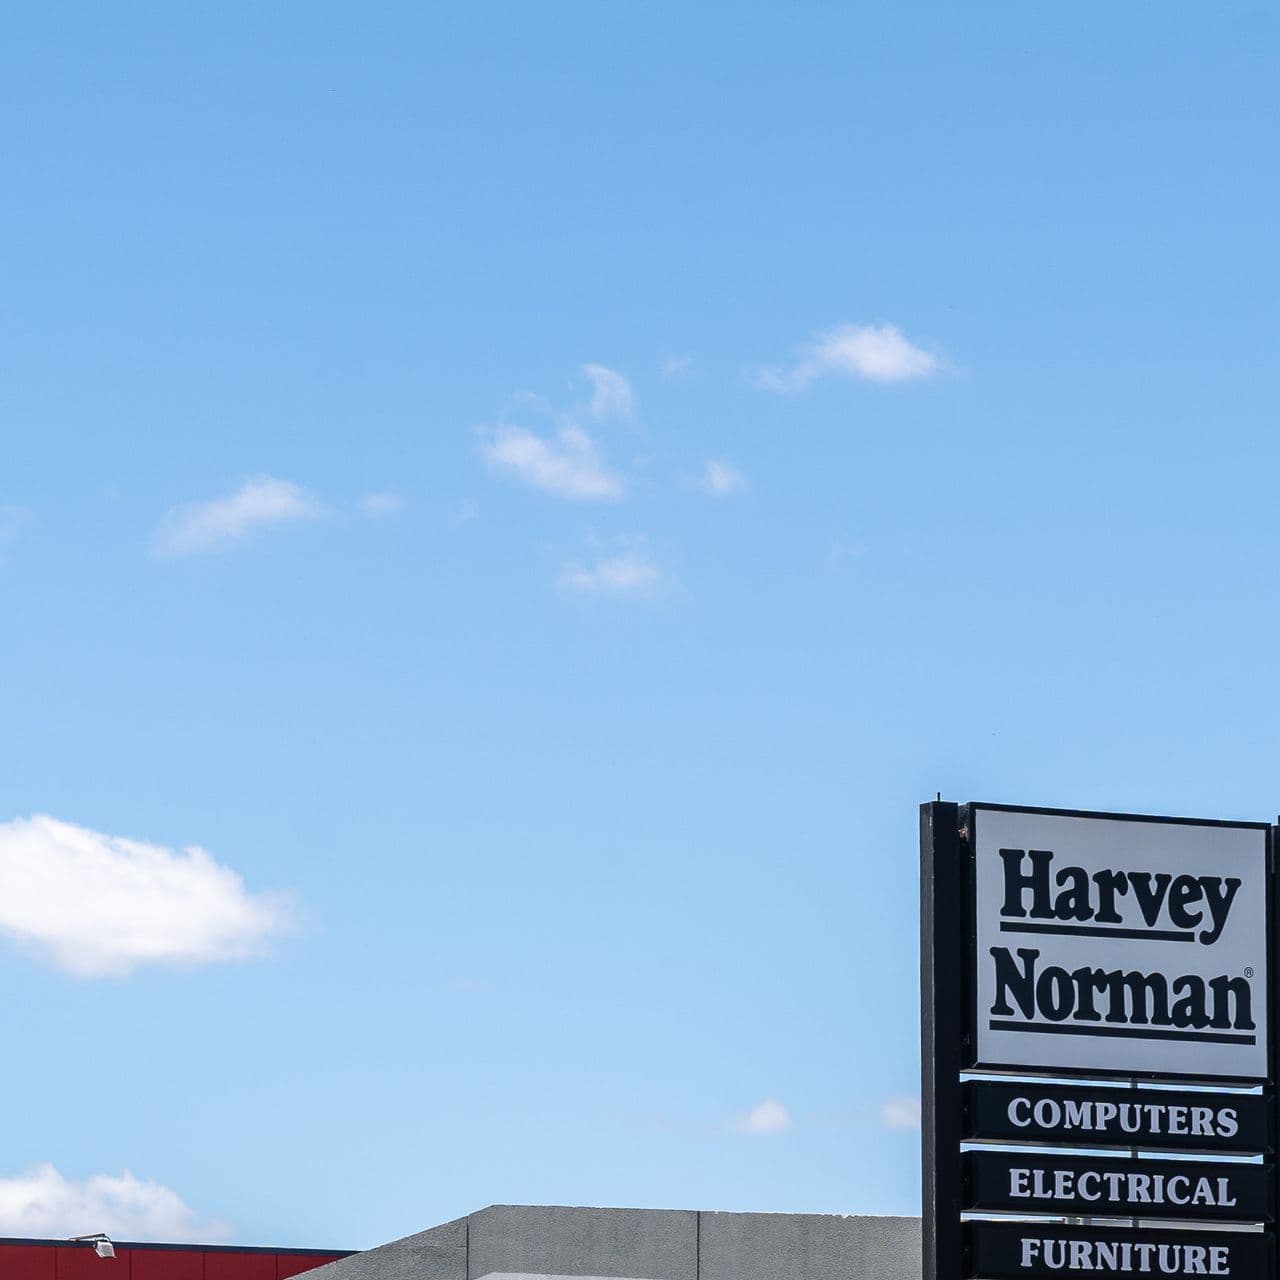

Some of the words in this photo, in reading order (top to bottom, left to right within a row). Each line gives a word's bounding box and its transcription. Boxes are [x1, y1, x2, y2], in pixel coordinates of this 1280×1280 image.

[999, 848, 1242, 945] Harvey
[1007, 1097, 1239, 1137] COMPUTERS
[1008, 1167, 1238, 1207] ELECTRICAL
[1020, 1238, 1230, 1276] FURNITURE
